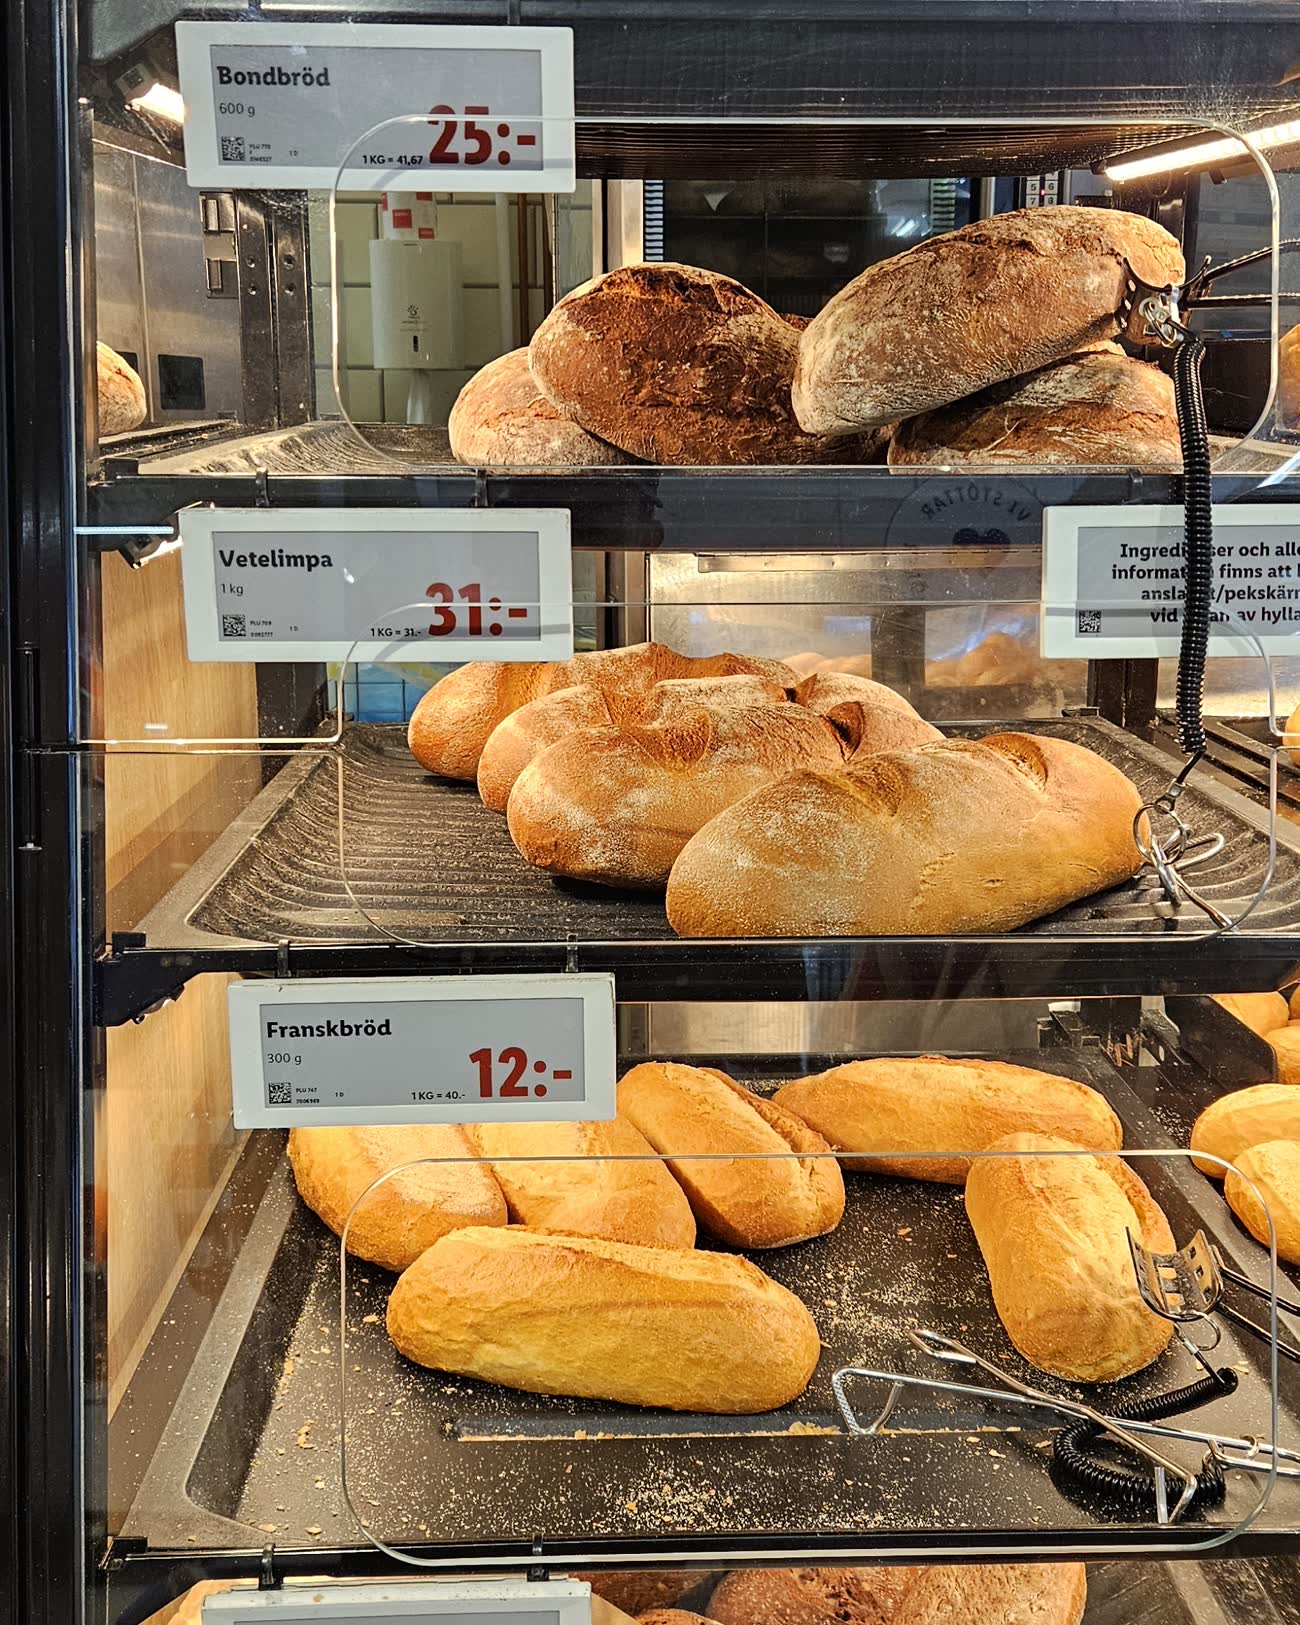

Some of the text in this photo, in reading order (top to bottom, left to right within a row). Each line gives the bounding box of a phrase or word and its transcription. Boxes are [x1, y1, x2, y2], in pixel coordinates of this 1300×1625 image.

[217, 66, 330, 86] Bondbröd
[220, 103, 256, 117] 600 g
[427, 104, 536, 165] 25:-
[362, 155, 368, 165] 1
[370, 155, 386, 165] KG
[397, 155, 423, 167] 41,67
[1030, 197, 1036, 205] 7
[1048, 196, 1053, 205] 8
[1238, 542, 1270, 557] och
[219, 549, 333, 572] Vetelimpa
[1220, 563, 1263, 578] finns
[1268, 565, 1292, 578] att
[221, 583, 244, 596] 1 kg
[425, 582, 528, 636] 31:-
[1151, 607, 1178, 622] vid
[1237, 610, 1256, 621] av
[370, 628, 375, 636] 1
[378, 628, 393, 636] KG
[404, 628, 421, 637] 31.-
[267, 1019, 392, 1038] Franskbröd
[267, 1053, 302, 1065] 300 g
[469, 1046, 572, 1097] 12:-
[411, 1092, 416, 1100] 1
[418, 1091, 434, 1100] KG
[445, 1091, 466, 1100] 40.-
